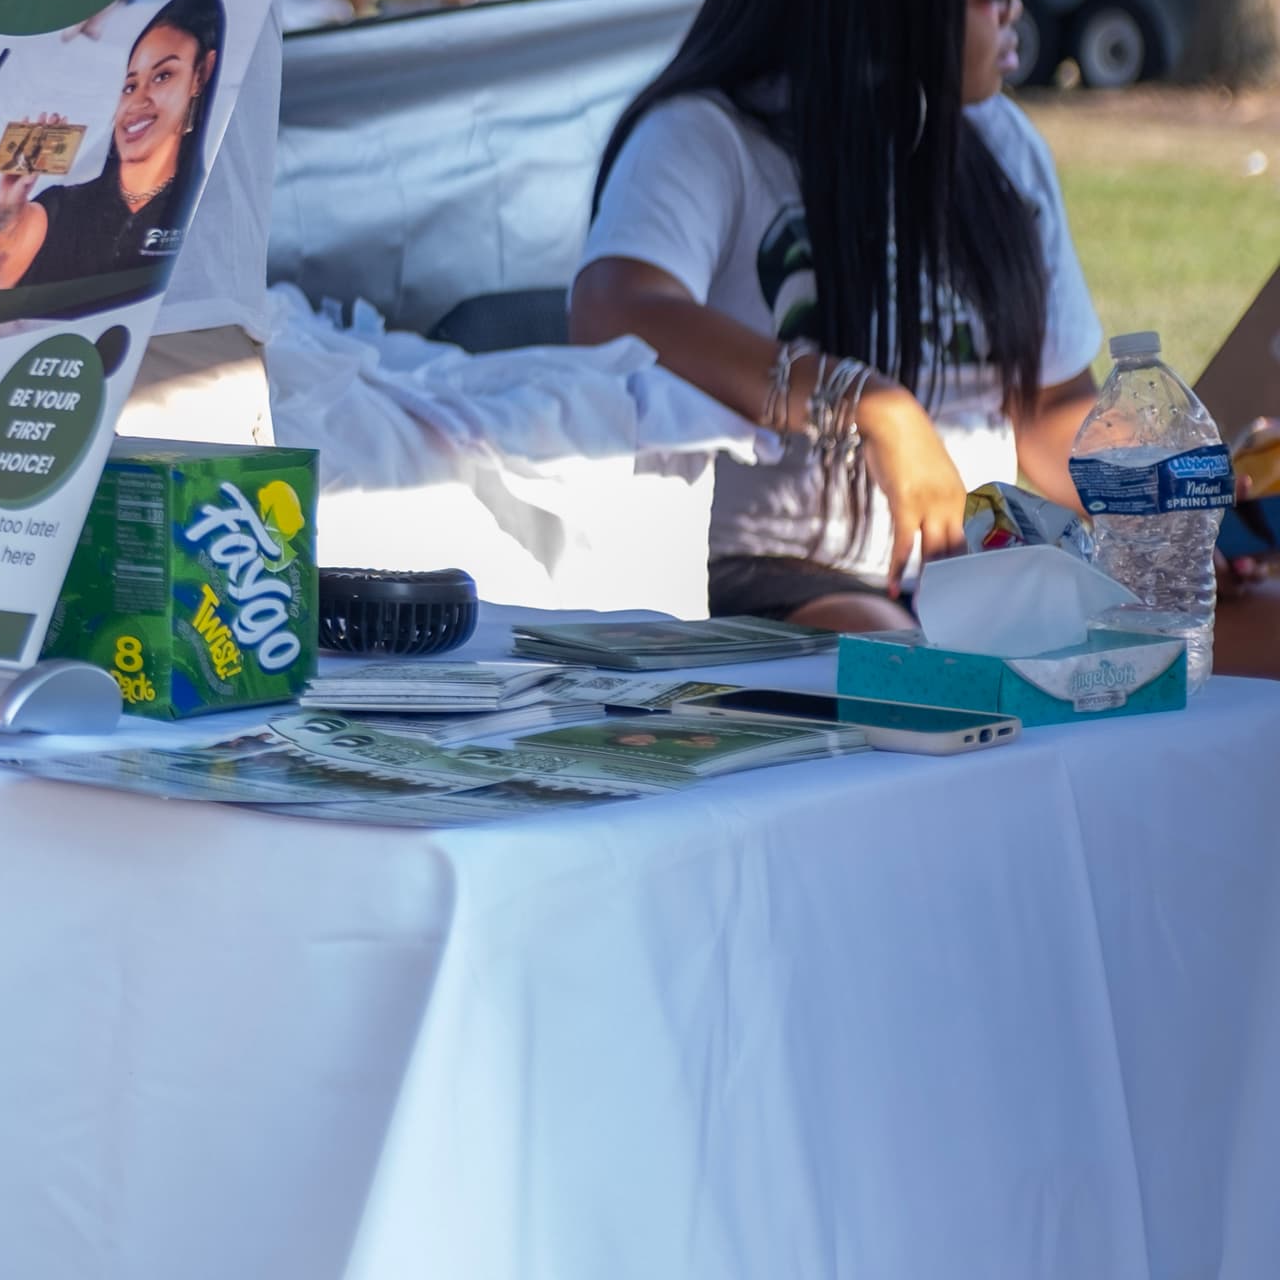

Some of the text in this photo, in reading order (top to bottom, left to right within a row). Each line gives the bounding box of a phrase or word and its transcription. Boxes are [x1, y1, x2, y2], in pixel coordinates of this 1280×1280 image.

[28, 357, 85, 378] LET US
[8, 387, 81, 412] BE YOUR
[6, 420, 56, 442] FIRST
[1185, 480, 1222, 496] Natural
[1166, 496, 1208, 509] SPRING
[25, 518, 61, 538] late!
[0, 545, 37, 566] here
[185, 481, 301, 671] Faygo
[192, 583, 243, 681] Twist!
[114, 635, 144, 673] 8
